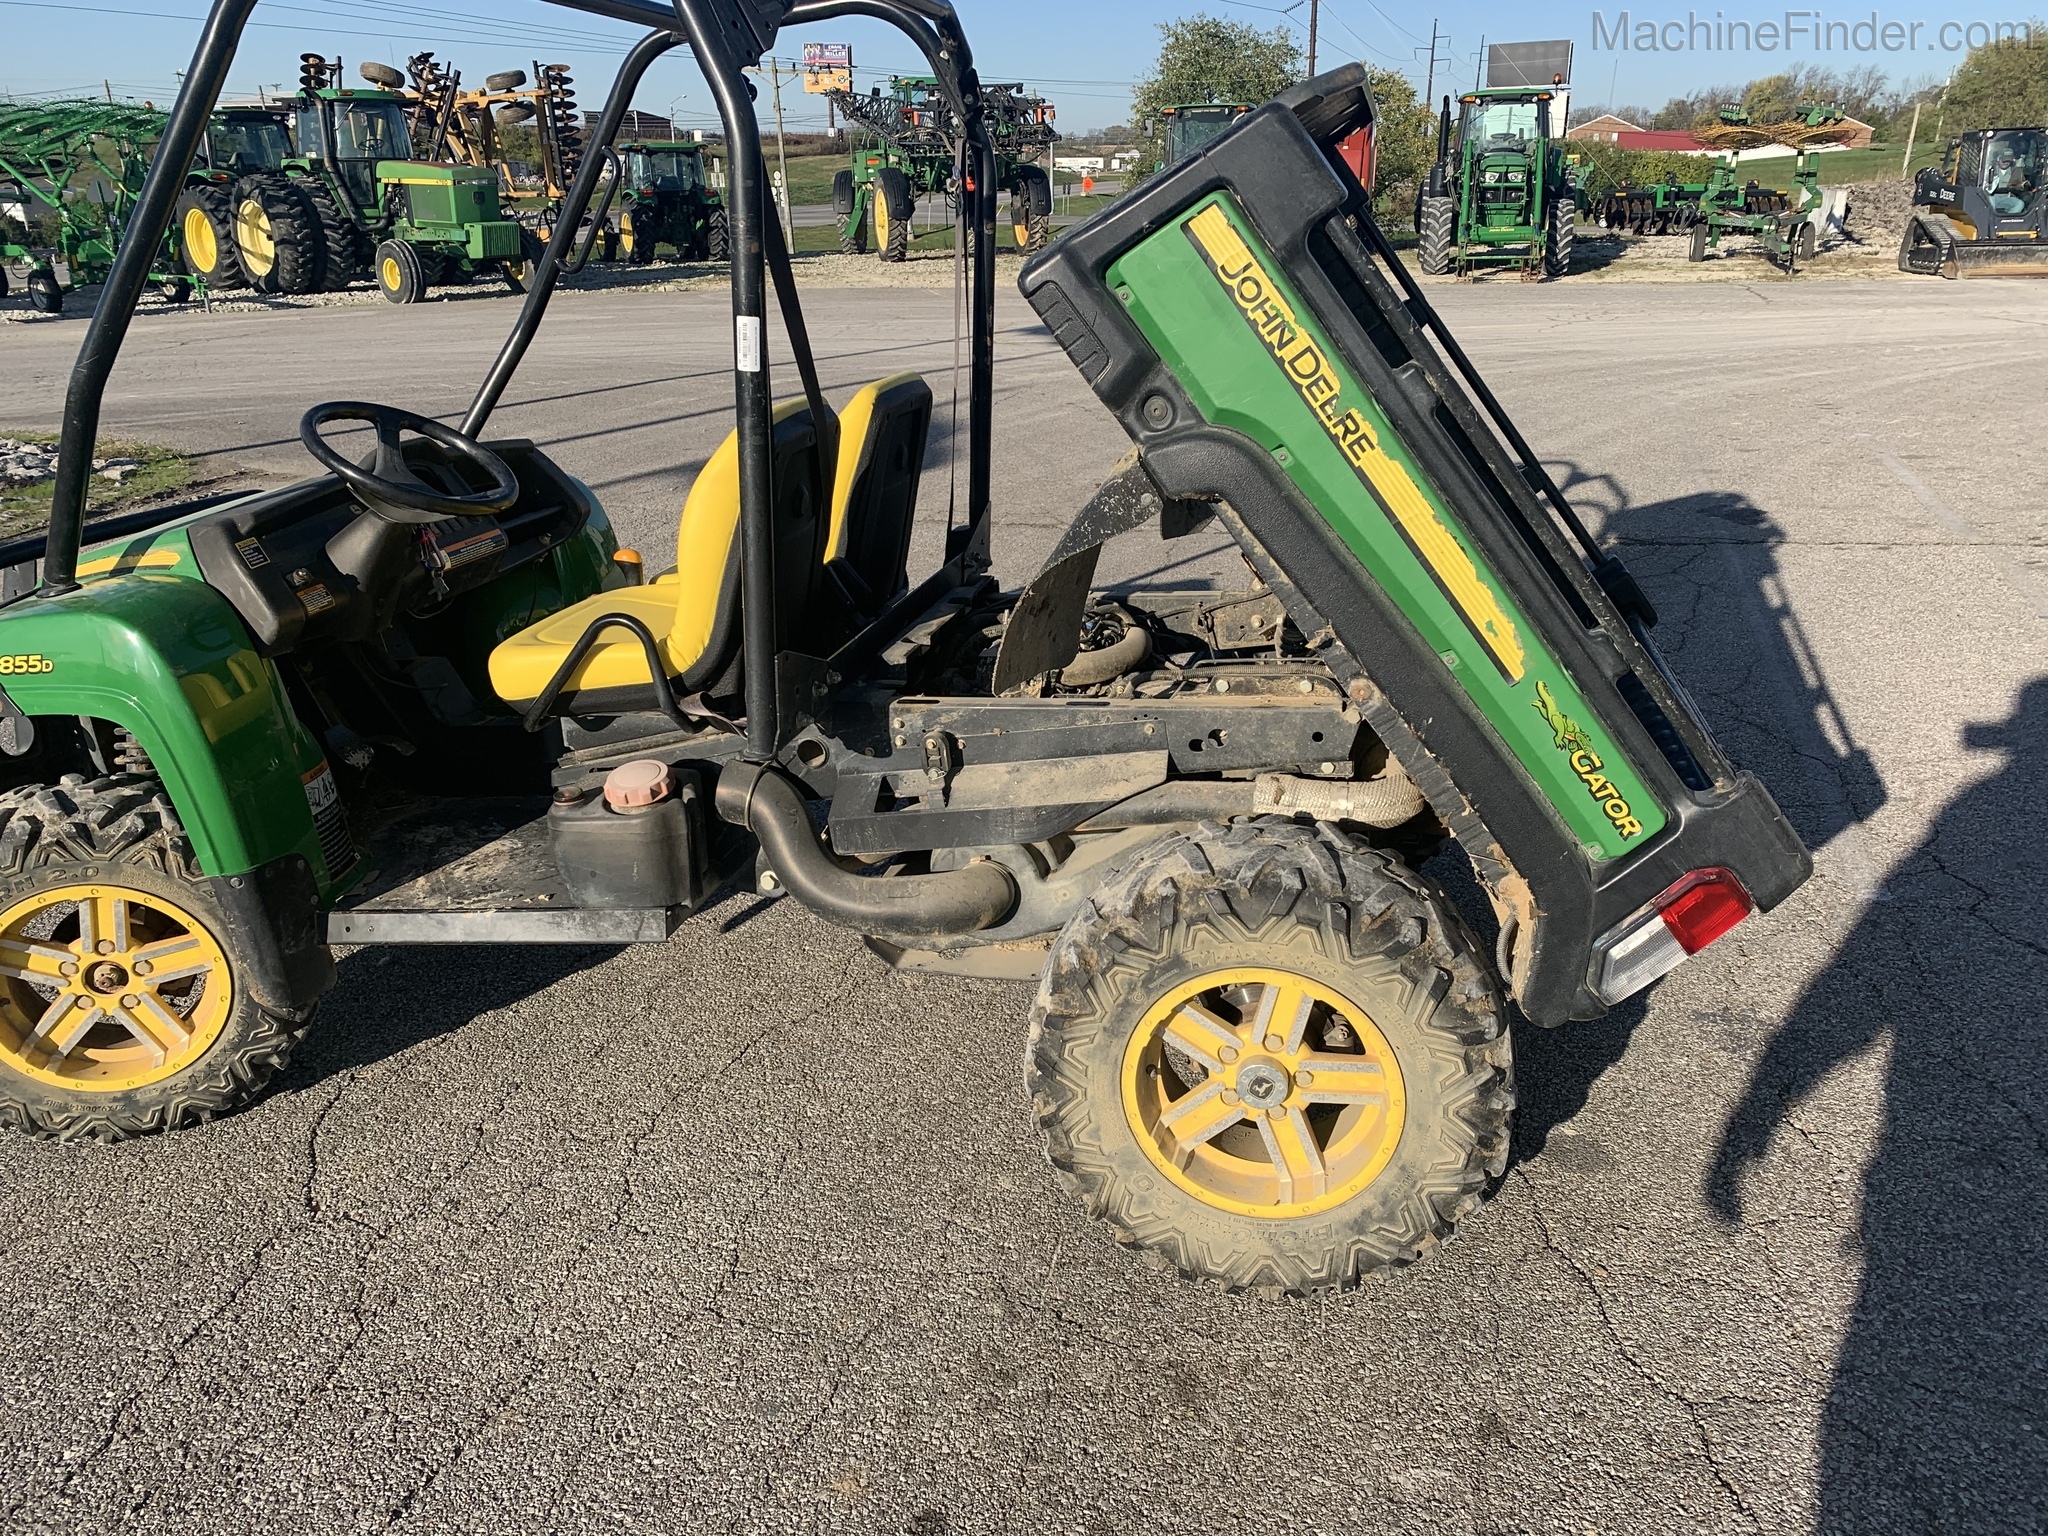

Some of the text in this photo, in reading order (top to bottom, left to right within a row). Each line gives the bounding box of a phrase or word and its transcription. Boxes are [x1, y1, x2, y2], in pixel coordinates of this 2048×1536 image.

[1940, 188, 1956, 202] DEERE
[1220, 261, 1377, 462] JOHN DEERE
[1570, 750, 1643, 840] GATOR
[47, 866, 99, 882] 2.0
